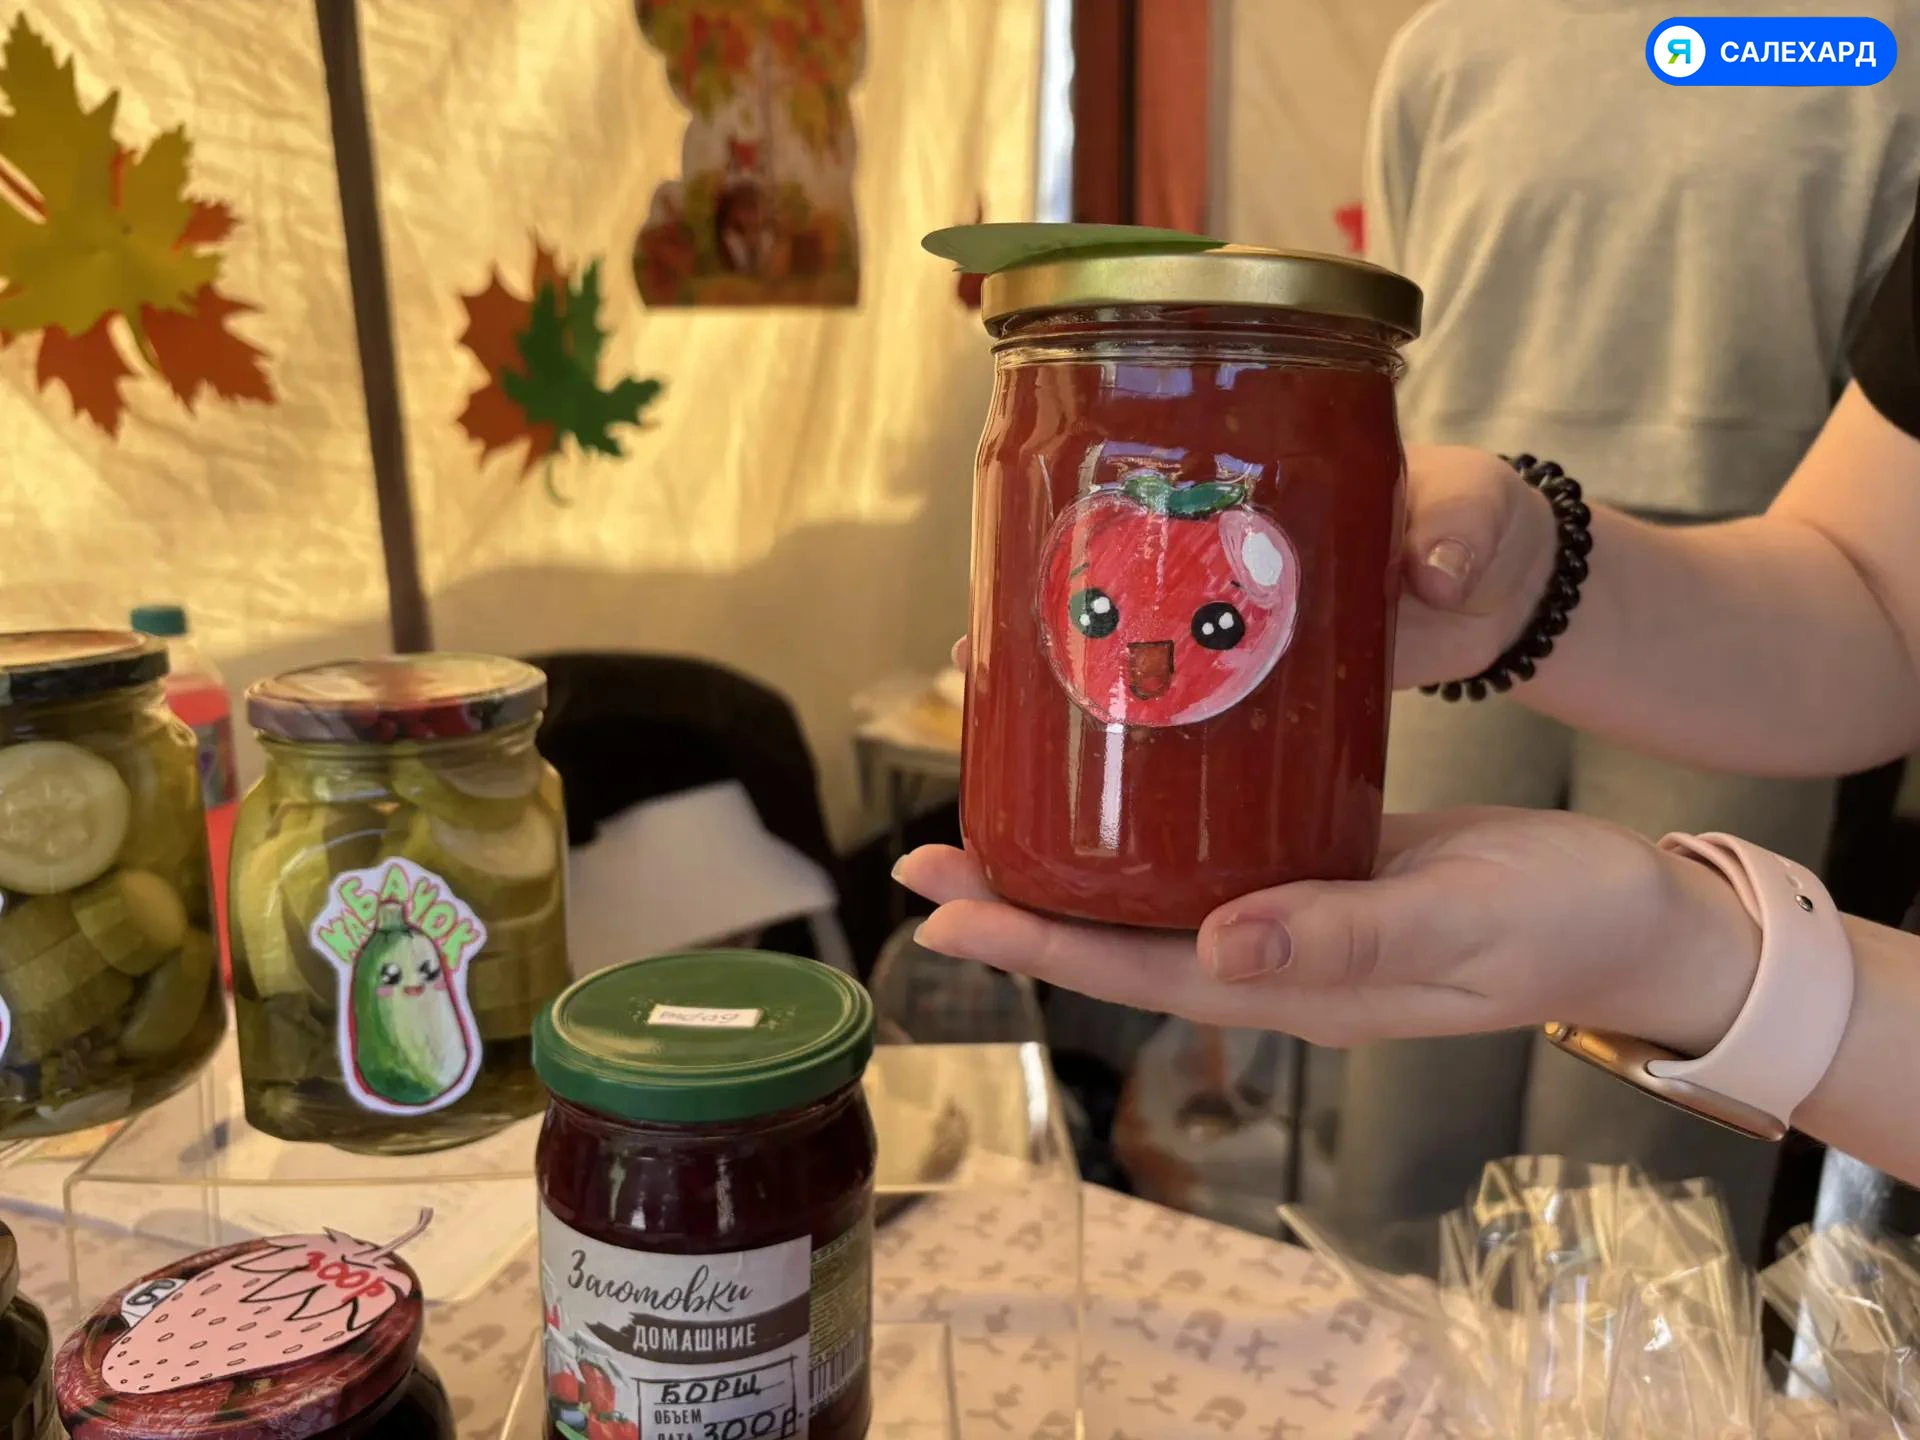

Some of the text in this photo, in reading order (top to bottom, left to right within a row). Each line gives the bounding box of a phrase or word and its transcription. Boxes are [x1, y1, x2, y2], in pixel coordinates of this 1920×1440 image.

[567, 1249, 754, 1312] Заготовки
[633, 1323, 757, 1352] ДОМАШНИЕ
[661, 1374, 761, 1404] БОРЩ
[654, 1408, 702, 1425] ОБЪЕМ
